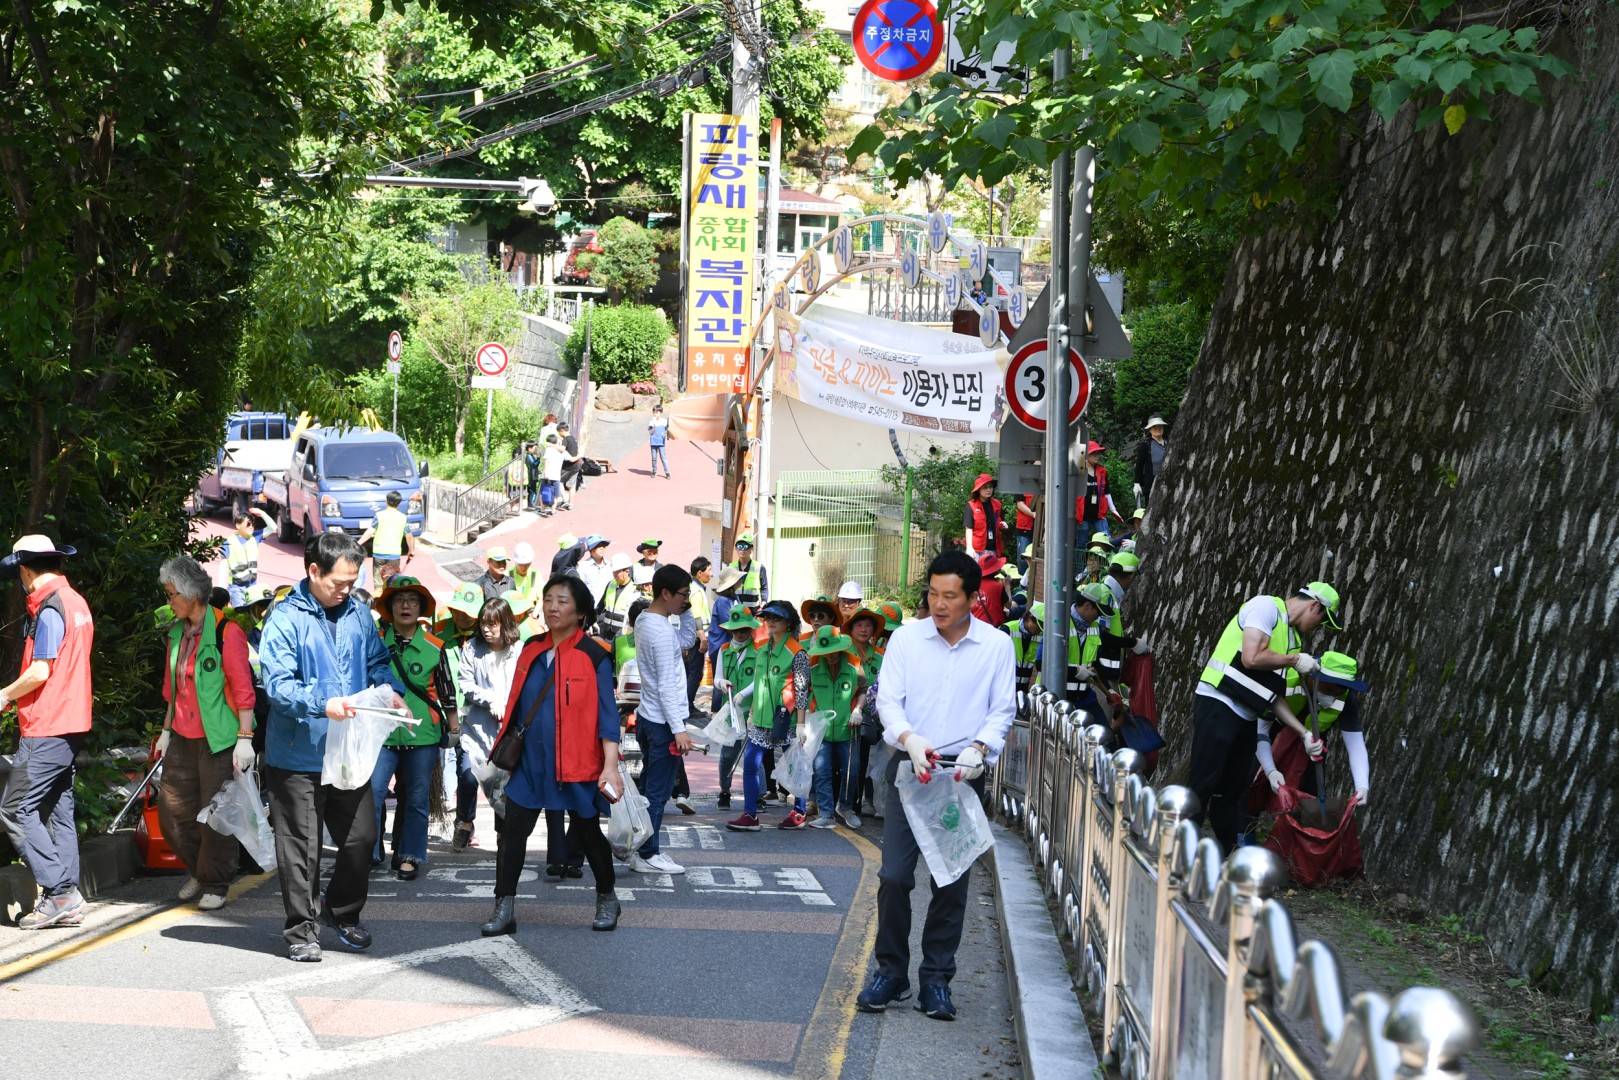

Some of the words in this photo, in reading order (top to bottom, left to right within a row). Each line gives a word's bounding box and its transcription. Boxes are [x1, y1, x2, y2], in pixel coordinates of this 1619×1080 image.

[866, 26, 930, 42] 주정차금지
[697, 124, 753, 209] 파랑새
[696, 216, 749, 234] 종합
[695, 236, 746, 252] 사회
[694, 259, 748, 343] 복지관
[692, 352, 746, 367] 유치원
[691, 373, 744, 387] 어린이집
[838, 358, 851, 385] &
[851, 361, 898, 396] 피아노
[902, 369, 949, 407] 이용자
[952, 371, 983, 412] 모집
